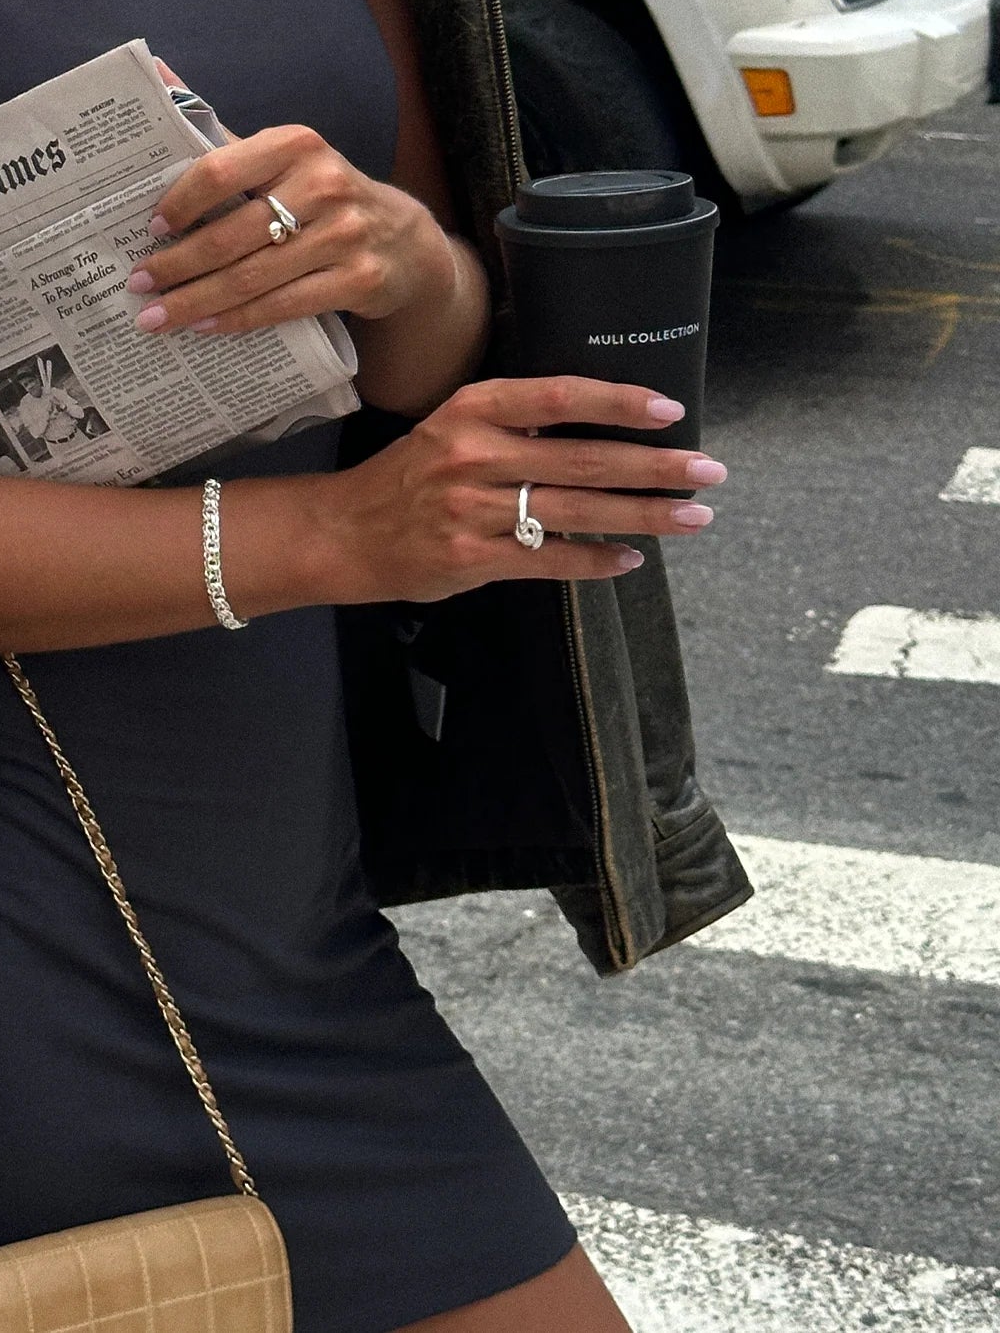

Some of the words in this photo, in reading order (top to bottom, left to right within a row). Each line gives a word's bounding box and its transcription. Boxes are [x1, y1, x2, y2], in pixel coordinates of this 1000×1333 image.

[113, 235, 132, 249] An
[131, 226, 149, 240] Ivy
[30, 278, 39, 291] A
[38, 263, 76, 287] Strange
[73, 250, 99, 269] Trip
[41, 291, 56, 305] To
[55, 263, 117, 300] Psychedelics
[56, 305, 74, 320] For
[588, 334, 624, 346] MULI
[627, 322, 700, 344] COLLECTION
